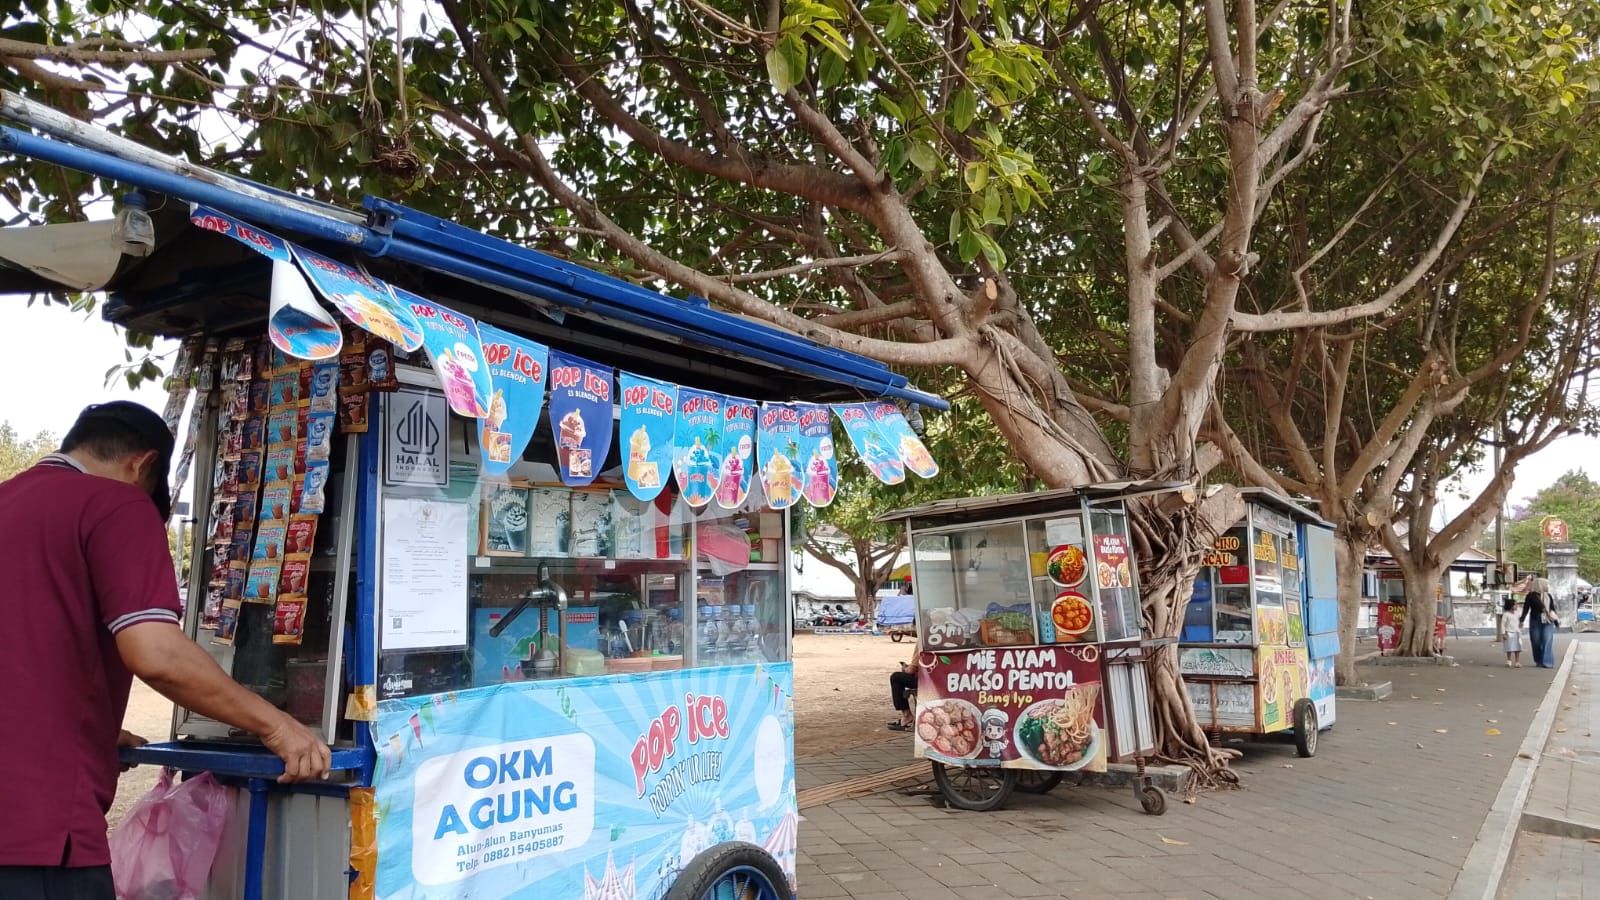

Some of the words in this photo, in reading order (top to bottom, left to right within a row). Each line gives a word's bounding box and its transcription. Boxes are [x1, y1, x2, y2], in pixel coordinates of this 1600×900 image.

[552, 366, 581, 390] POP
[624, 385, 649, 409] POP
[682, 398, 701, 419] POP
[726, 404, 739, 420] OP
[762, 409, 777, 431] POP
[800, 410, 815, 431] POP
[396, 455, 439, 467] HALAL
[1213, 537, 1239, 550] CINO
[1201, 553, 1230, 566] NCAU
[1387, 605, 1405, 613] DIM
[1001, 648, 1056, 669] AYAM
[947, 670, 1003, 692] BAKSO
[1008, 670, 1077, 691] PENTOL
[978, 691, 1010, 707] Bang
[1013, 691, 1033, 708] Iyo
[630, 704, 681, 799] POP
[464, 746, 553, 789] OKM
[701, 751, 722, 782] LIFE!
[433, 781, 577, 840] AGUNG
[509, 823, 563, 842] Banyumas
[483, 835, 564, 863] 088215405887
